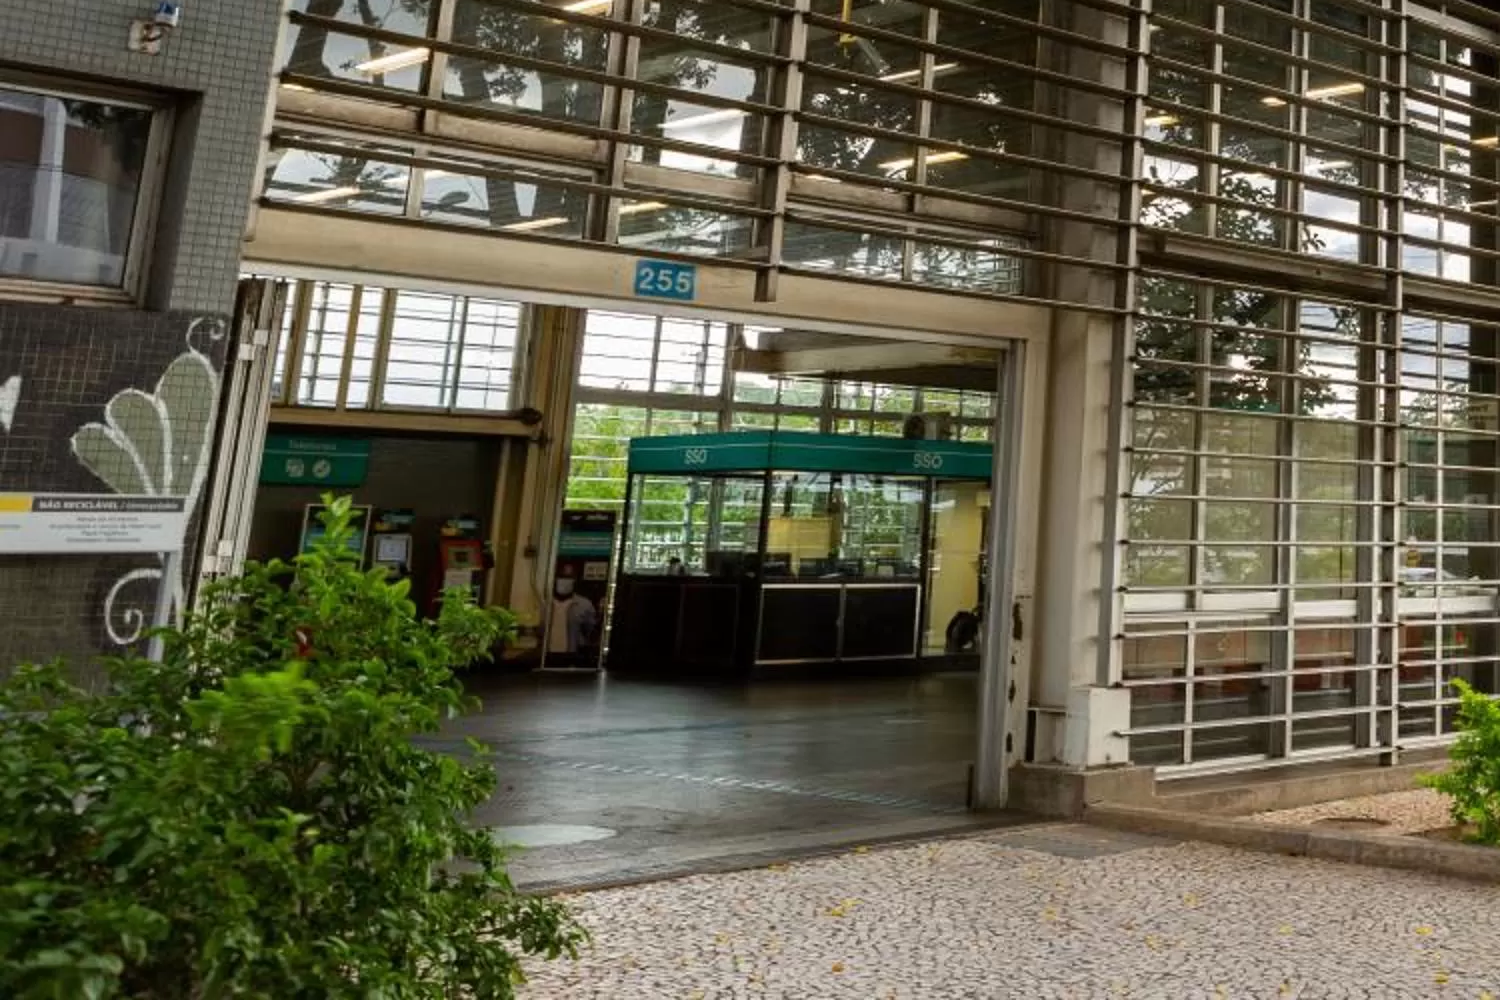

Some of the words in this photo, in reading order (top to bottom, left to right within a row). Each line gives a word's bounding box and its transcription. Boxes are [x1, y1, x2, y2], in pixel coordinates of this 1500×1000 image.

[639, 267, 691, 293] 255
[684, 448, 708, 465] SSO
[913, 453, 943, 469] SSO
